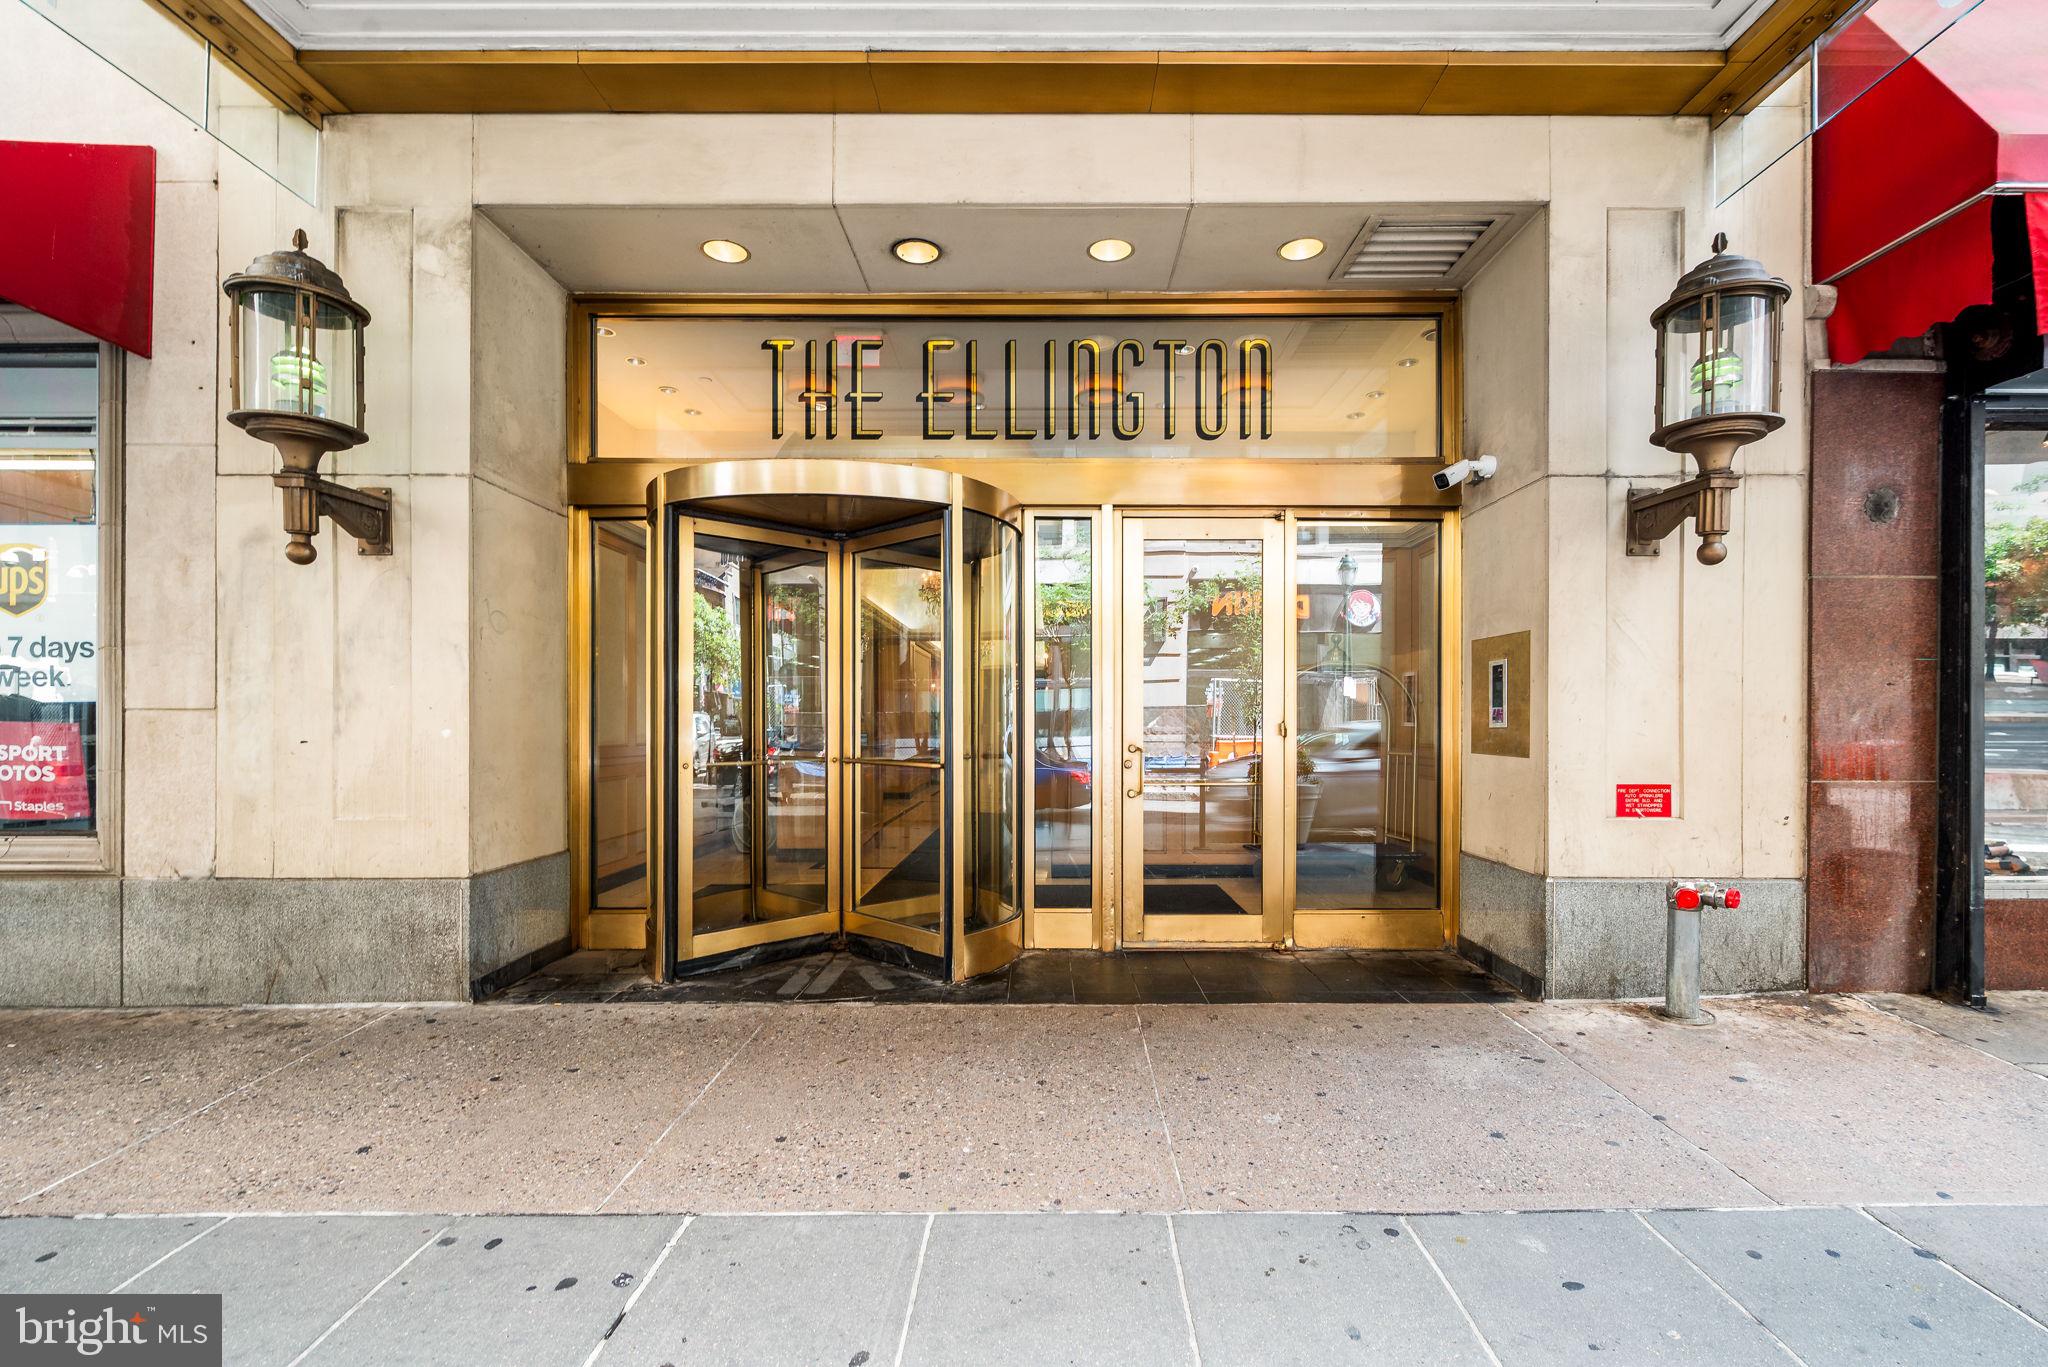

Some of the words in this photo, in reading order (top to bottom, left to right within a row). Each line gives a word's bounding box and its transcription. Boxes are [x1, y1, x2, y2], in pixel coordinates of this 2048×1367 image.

[761, 339, 883, 440] THE
[916, 338, 1272, 440] ELLINGTON
[7, 636, 23, 658] 7
[29, 635, 95, 663] days
[14, 801, 64, 814] Staples
